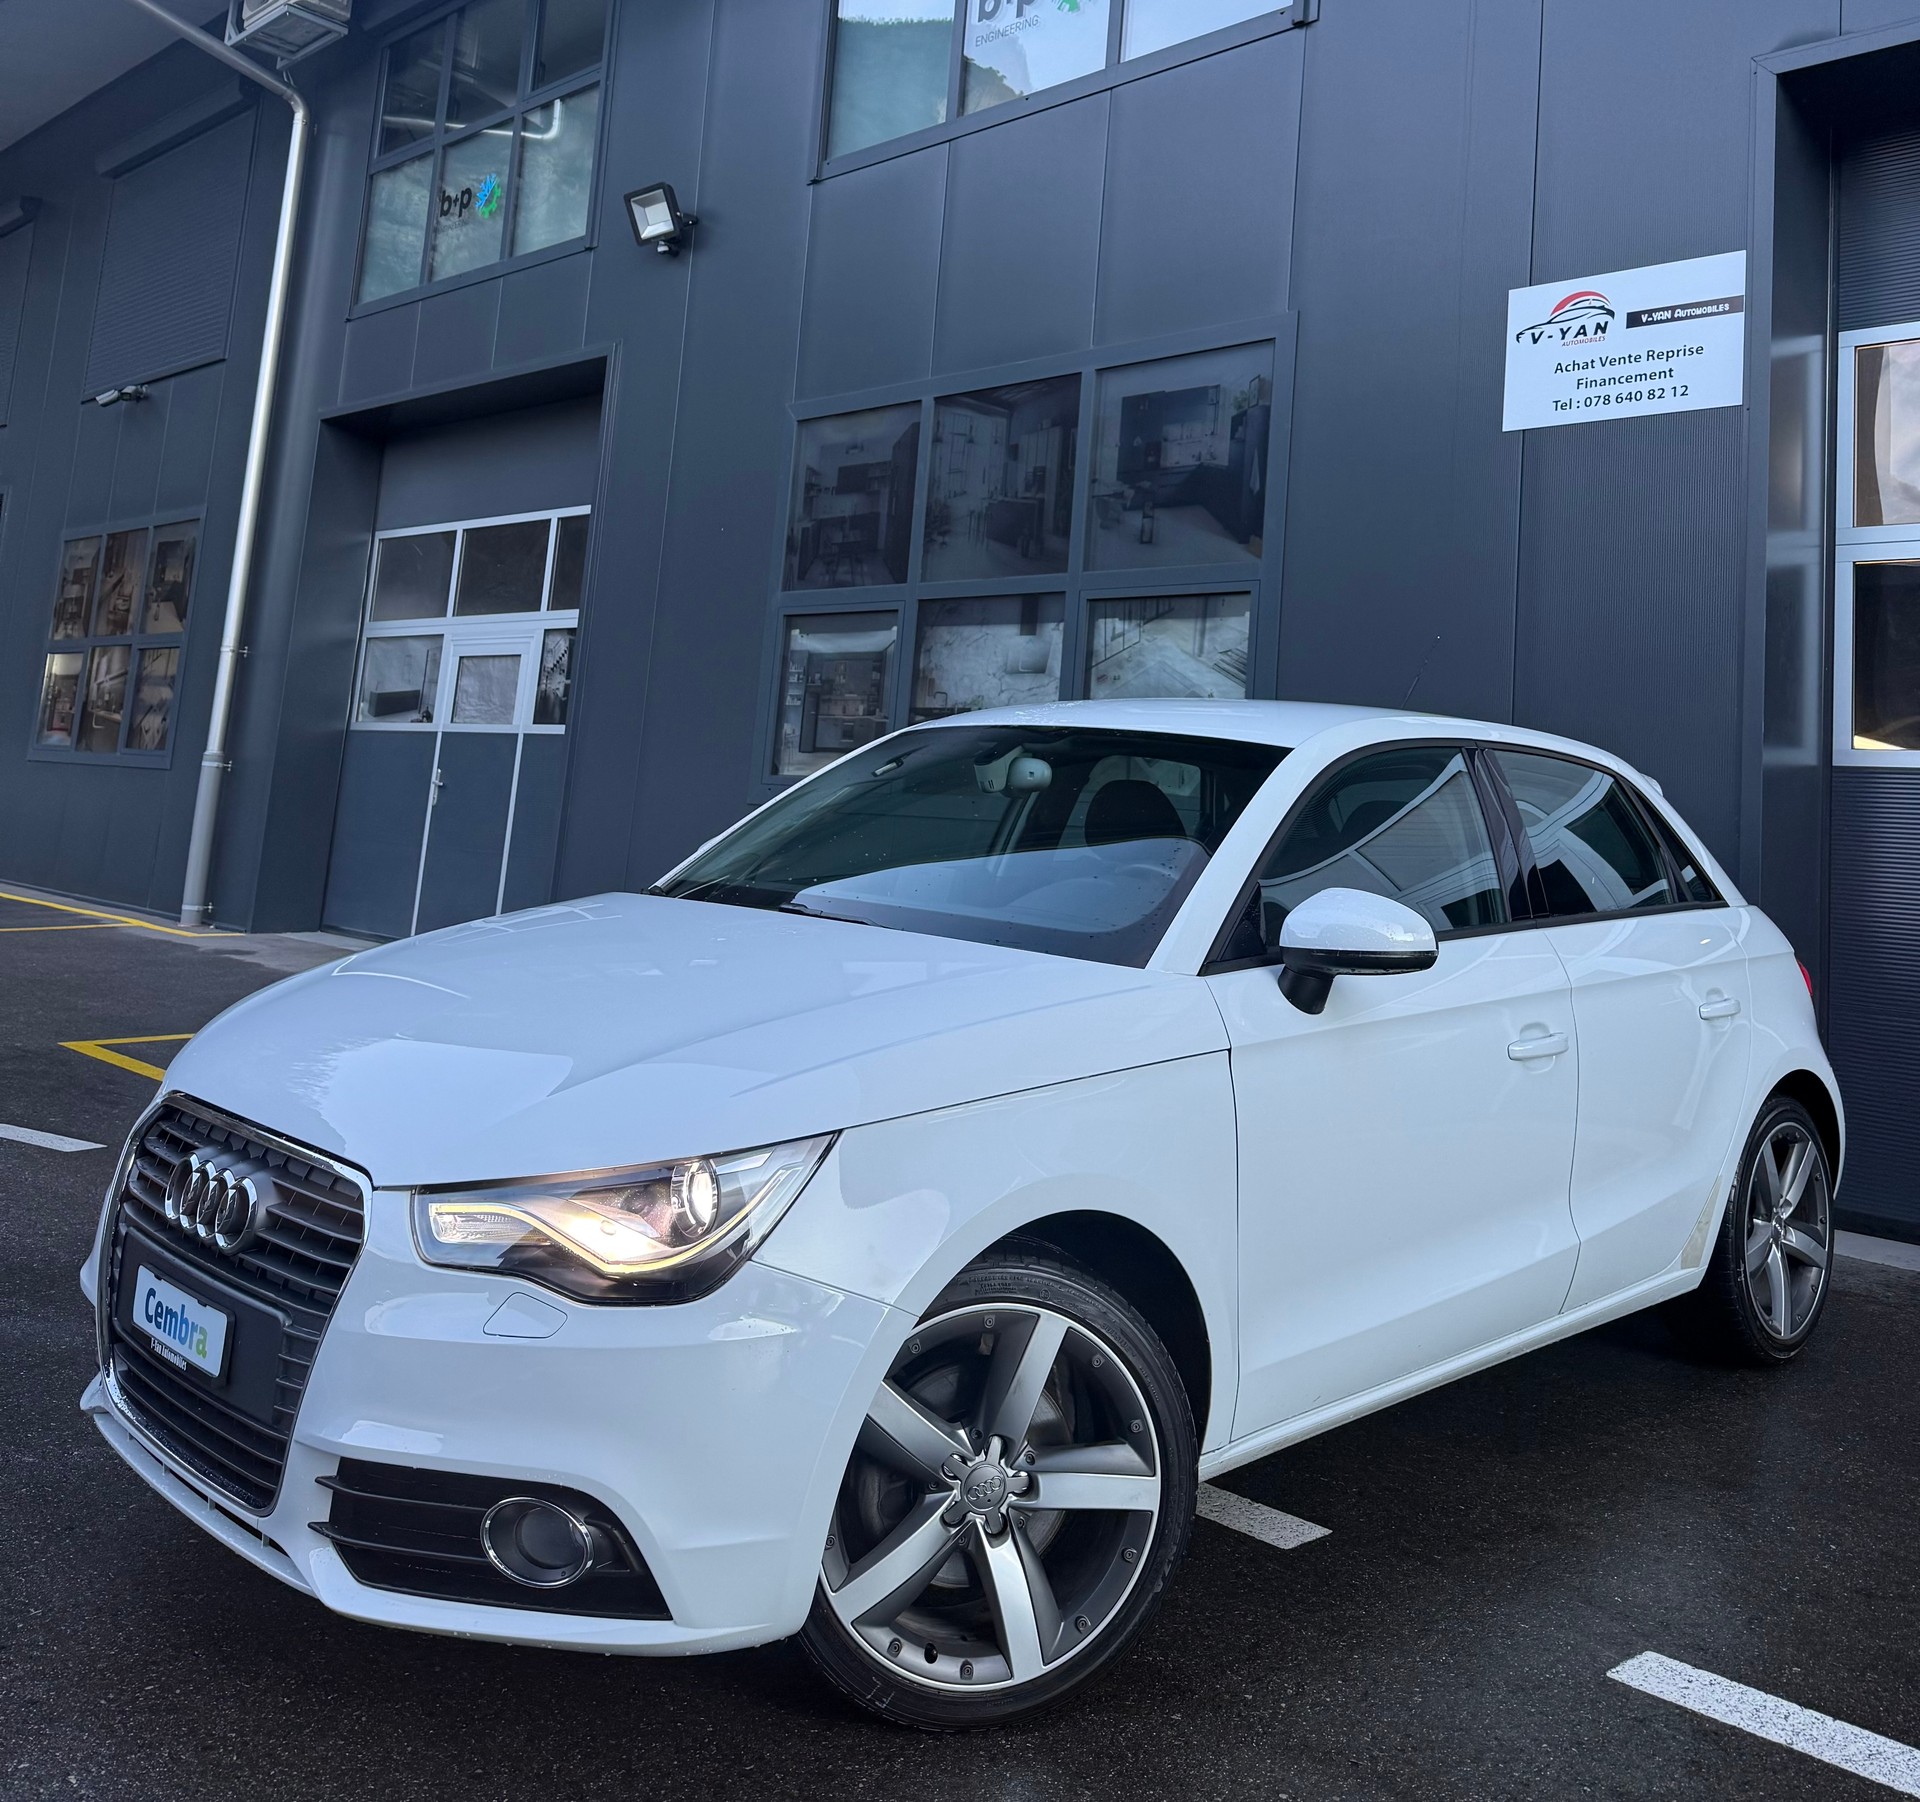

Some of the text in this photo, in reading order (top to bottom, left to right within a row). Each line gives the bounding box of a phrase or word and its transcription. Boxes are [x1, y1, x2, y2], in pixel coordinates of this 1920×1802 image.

[975, 14, 1041, 47] ENGINEERING
[440, 187, 472, 218] b+p
[1641, 309, 1672, 323] V-YAN
[1530, 320, 1609, 345] V-YAN
[1561, 335, 1606, 347] AUTOMOBILES
[1554, 344, 1704, 374] Achat Vente Reprise
[1576, 367, 1674, 390] Financement
[1584, 394, 1611, 409] 078
[1615, 389, 1643, 404] 640
[1647, 386, 1666, 401] 82
[1671, 384, 1689, 398] 12
[144, 1287, 208, 1359] Cembra
